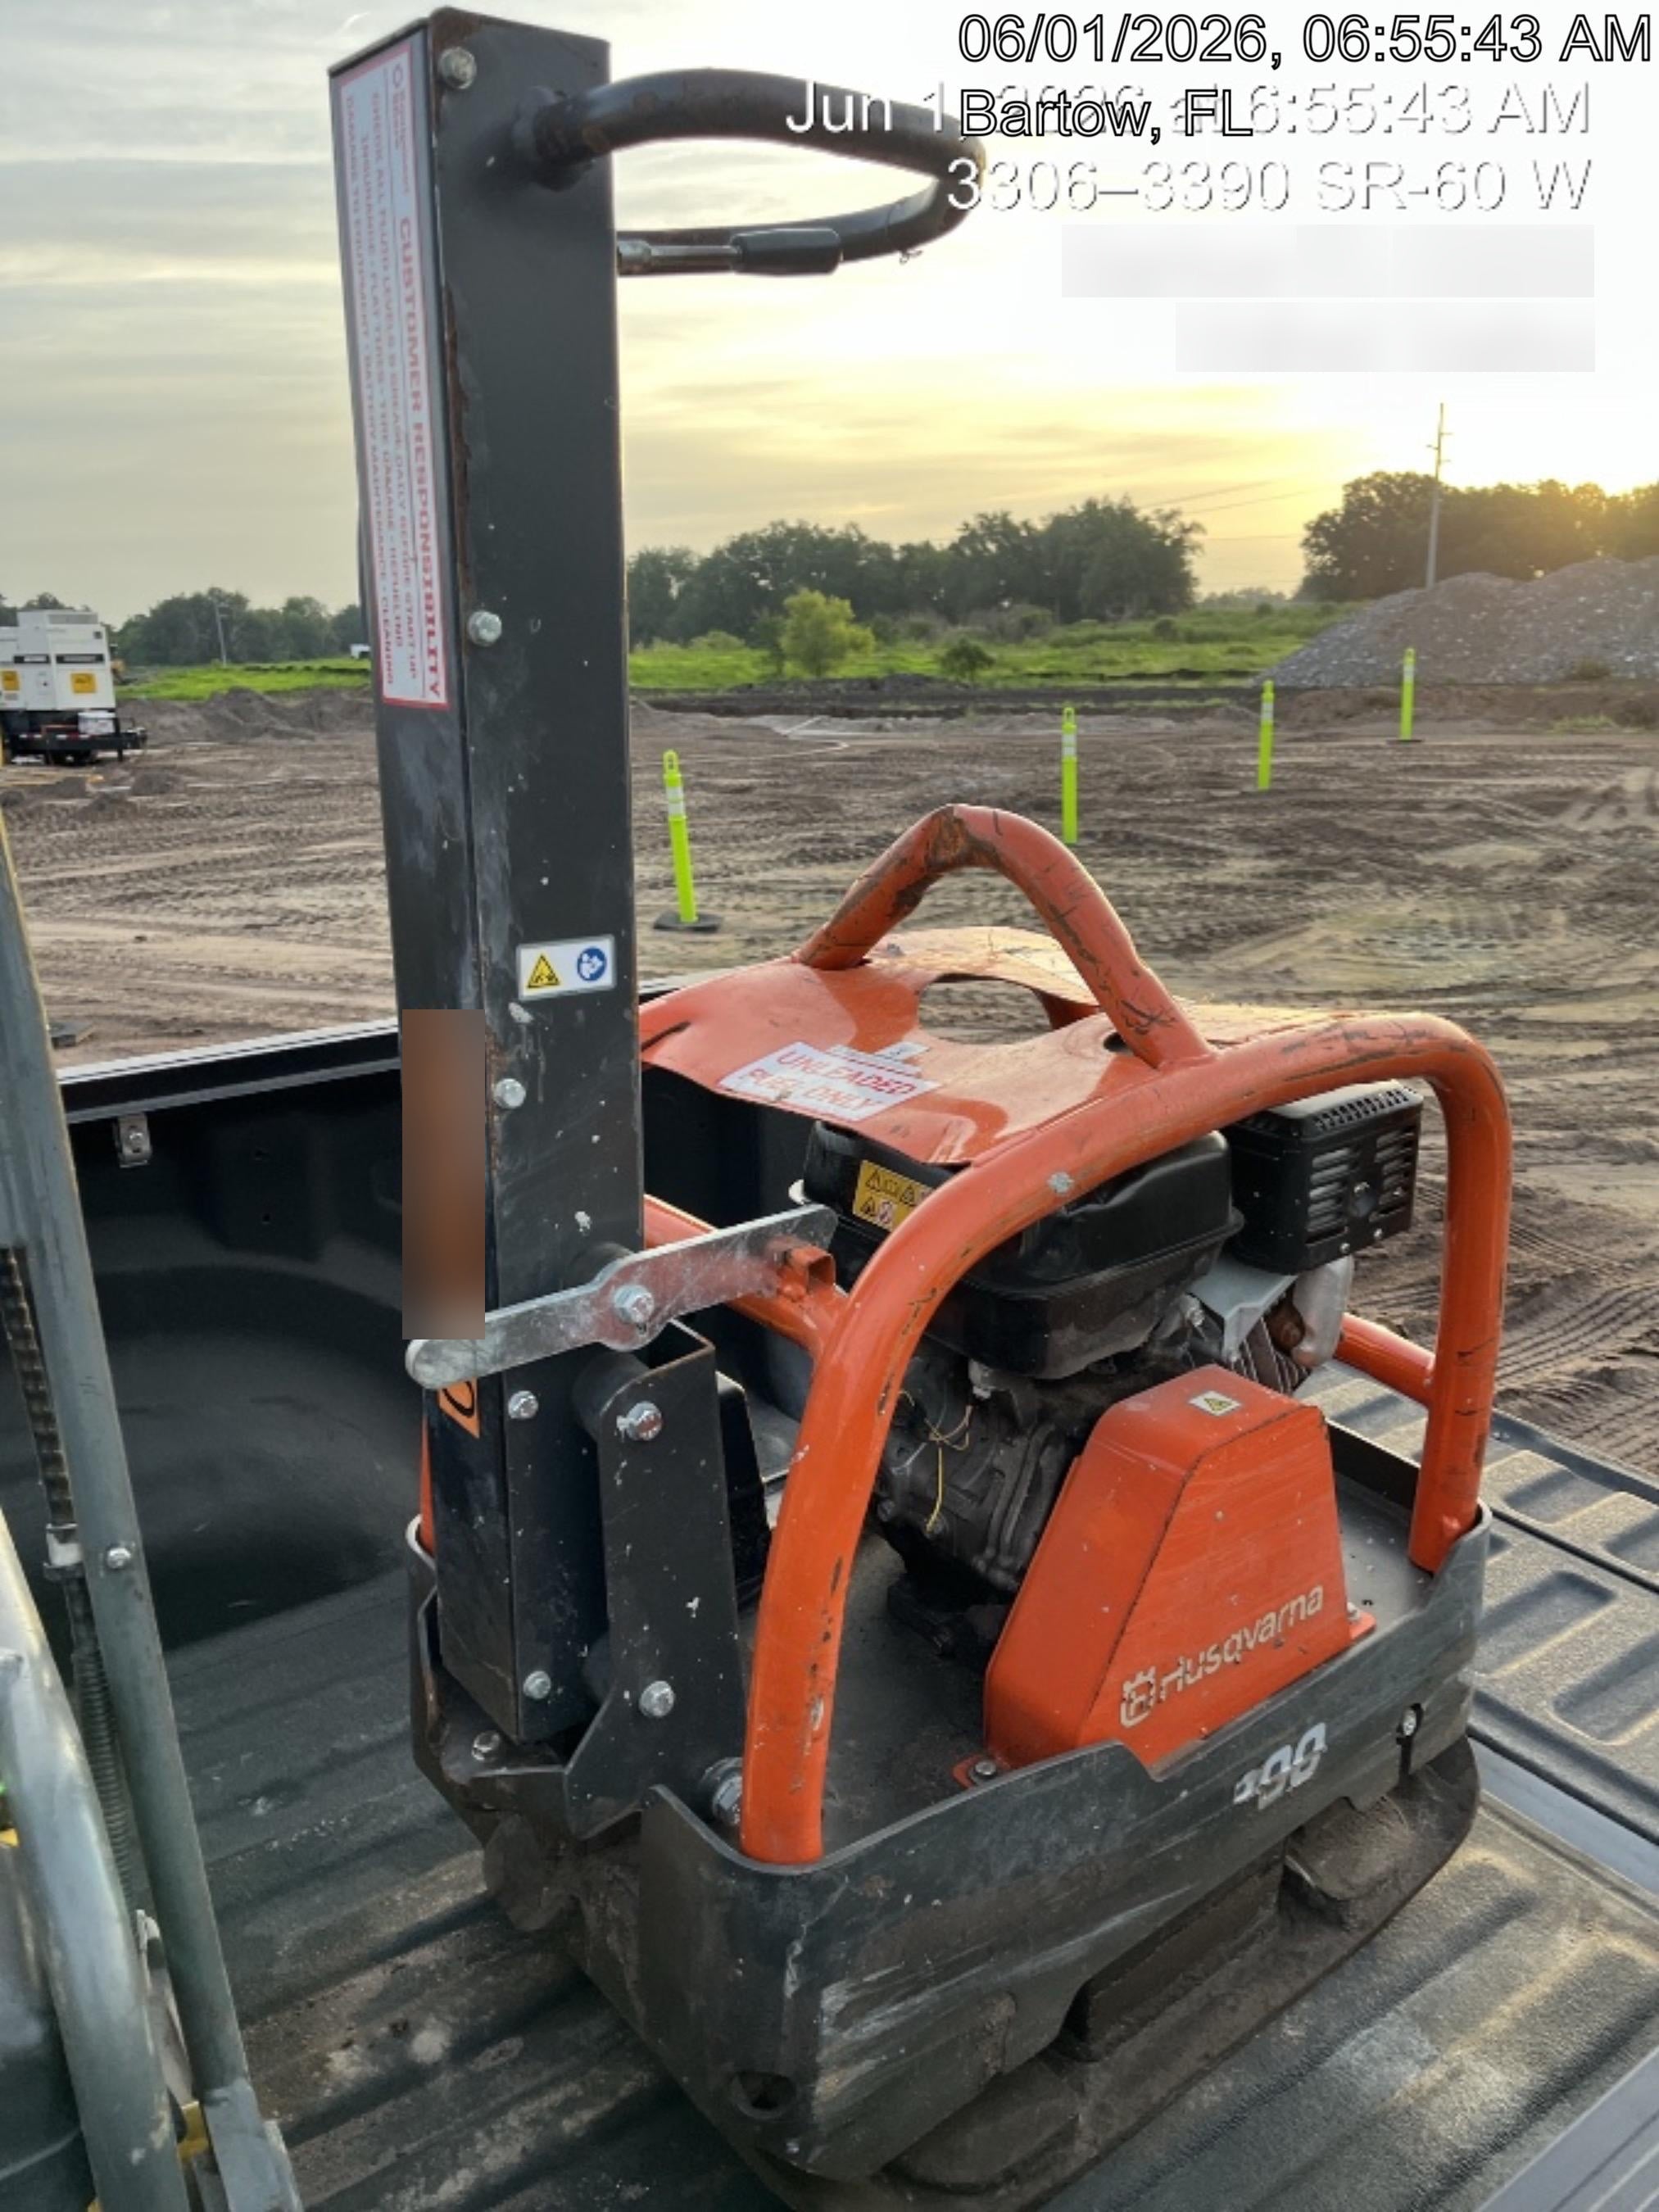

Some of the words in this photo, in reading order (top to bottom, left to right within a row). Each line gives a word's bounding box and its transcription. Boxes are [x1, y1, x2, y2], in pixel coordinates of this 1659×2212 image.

[401, 215, 421, 412] CUSTOMER
[413, 421, 439, 697] RESPONSIBILITY
[1160, 1584, 1324, 1703] Husqvarna
